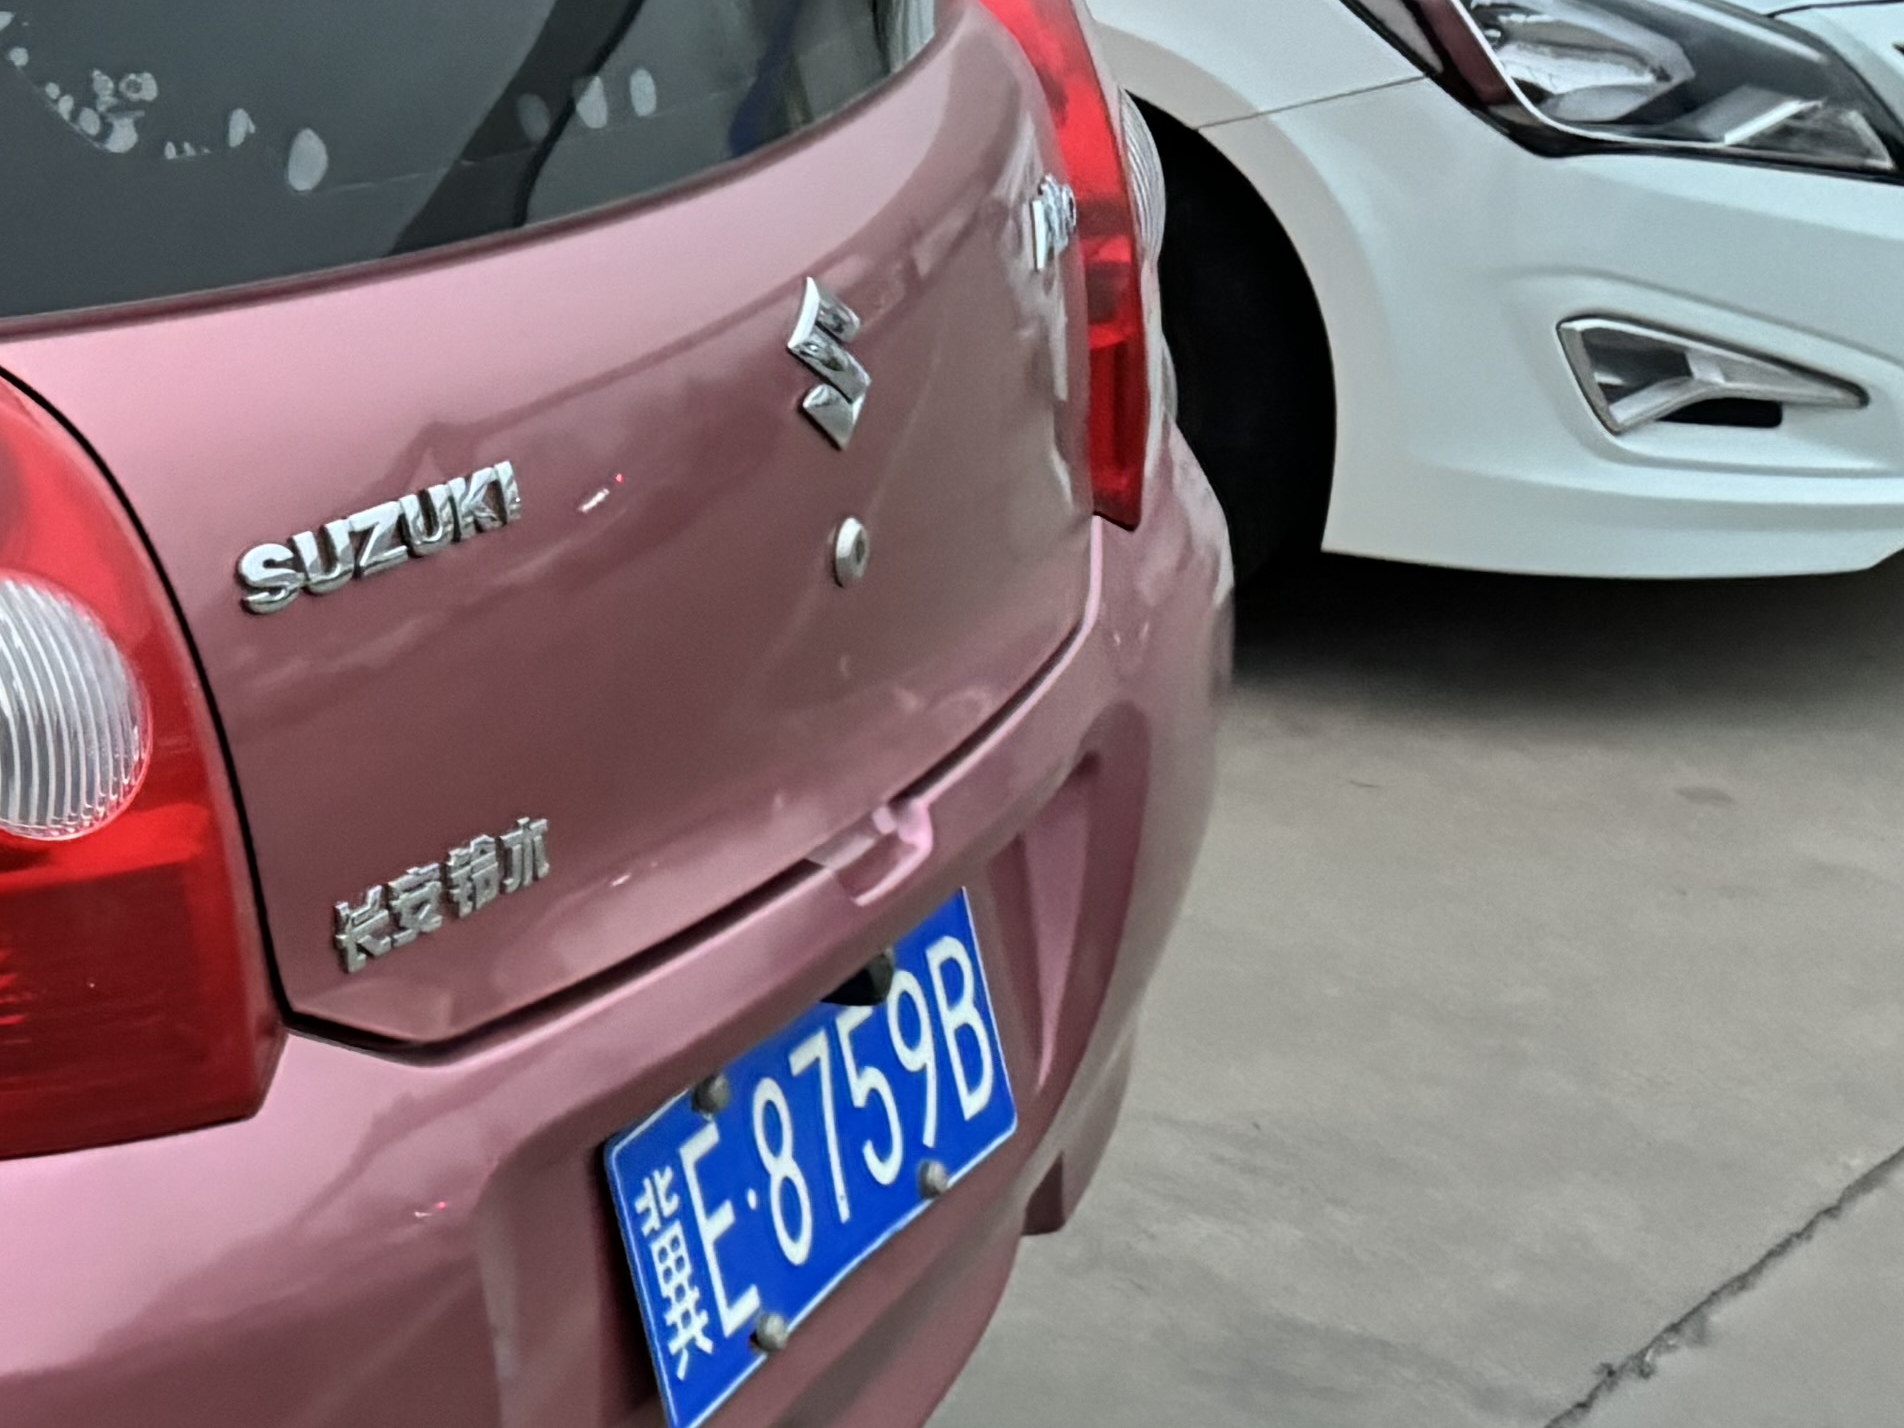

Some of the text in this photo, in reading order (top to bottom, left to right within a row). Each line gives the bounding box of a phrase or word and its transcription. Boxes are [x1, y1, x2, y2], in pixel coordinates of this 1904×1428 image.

[237, 459, 523, 614] SUZUKI
[333, 816, 552, 973] 长安铃木
